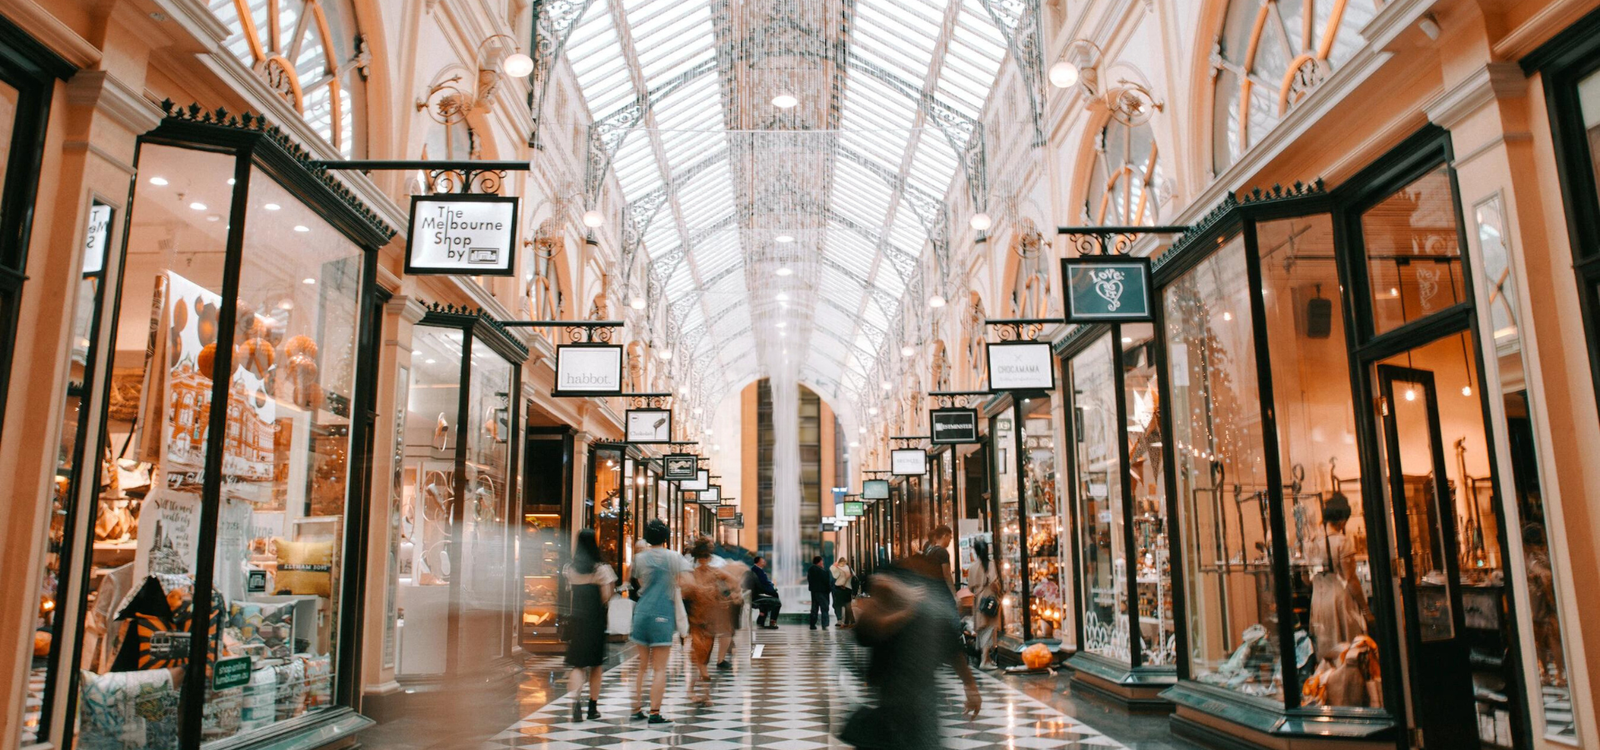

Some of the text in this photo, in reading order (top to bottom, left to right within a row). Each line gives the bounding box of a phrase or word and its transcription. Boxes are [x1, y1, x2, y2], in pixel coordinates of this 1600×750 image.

[438, 206, 463, 218] The
[422, 217, 503, 231] Melbourne
[434, 232, 472, 248] Shop
[447, 250, 465, 261] by
[997, 365, 1040, 374] CHOCAMAMA
[566, 373, 612, 384] habbot.
